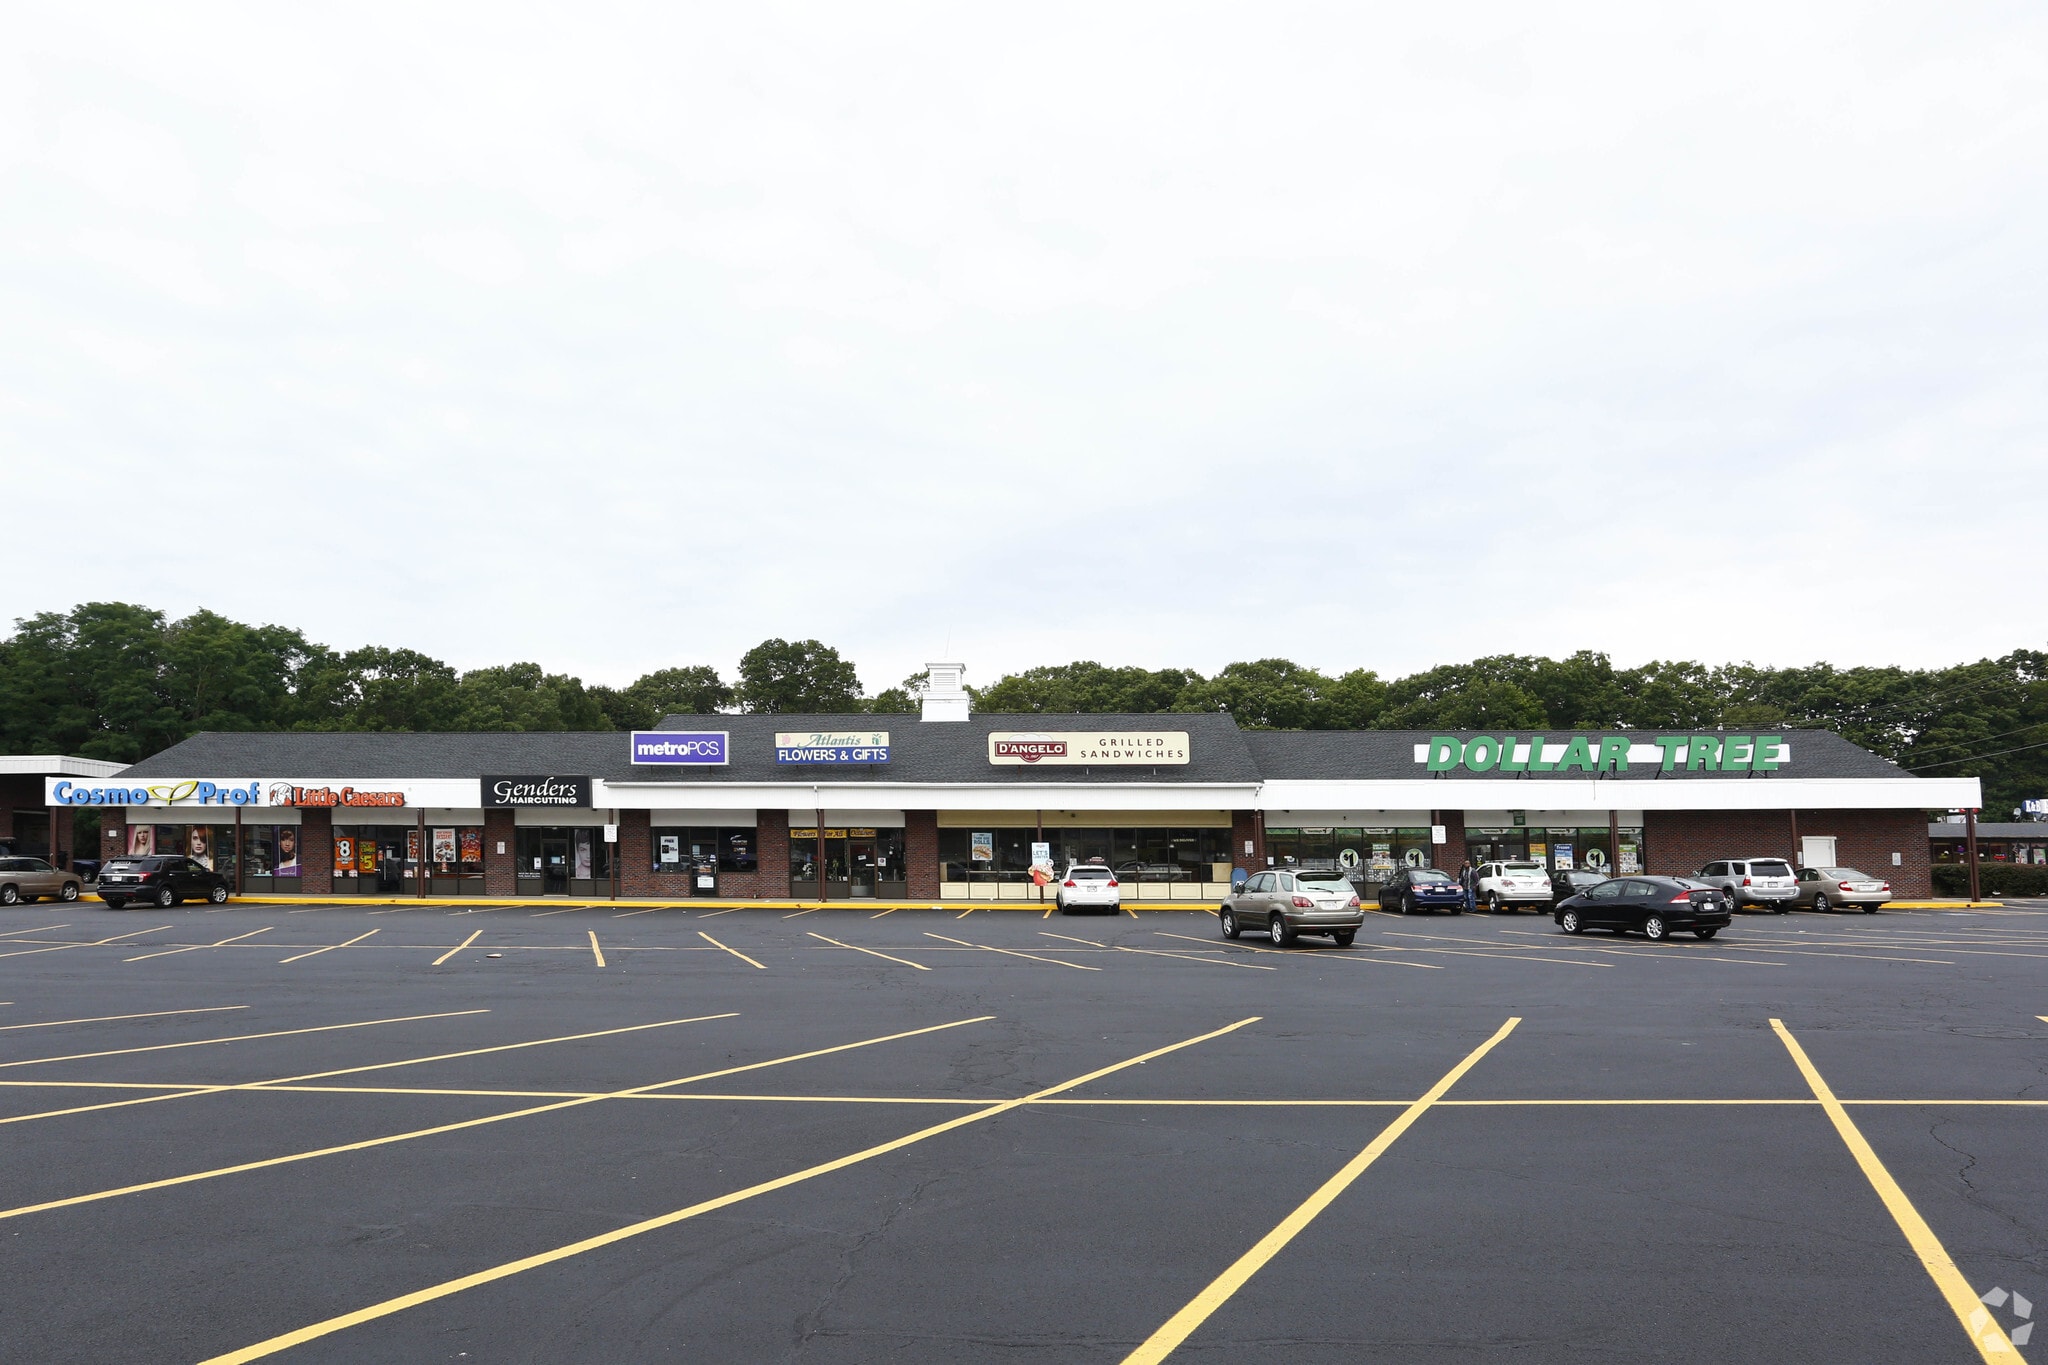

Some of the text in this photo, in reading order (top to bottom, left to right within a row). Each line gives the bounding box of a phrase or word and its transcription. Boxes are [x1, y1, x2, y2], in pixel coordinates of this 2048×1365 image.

[797, 734, 862, 749] Atlantis
[1000, 744, 1063, 753] D'ANGELO
[778, 749, 887, 761] FLOWERS & GIFTS
[1080, 750, 1184, 758] SANDWICHES
[1427, 736, 1783, 772] DOLLAR TREE
[53, 781, 260, 804] Cosmo Prof
[293, 787, 404, 806] Little Caesars
[493, 777, 577, 804] Genders
[1344, 853, 1354, 867] $1
[1590, 853, 1601, 867] $1
